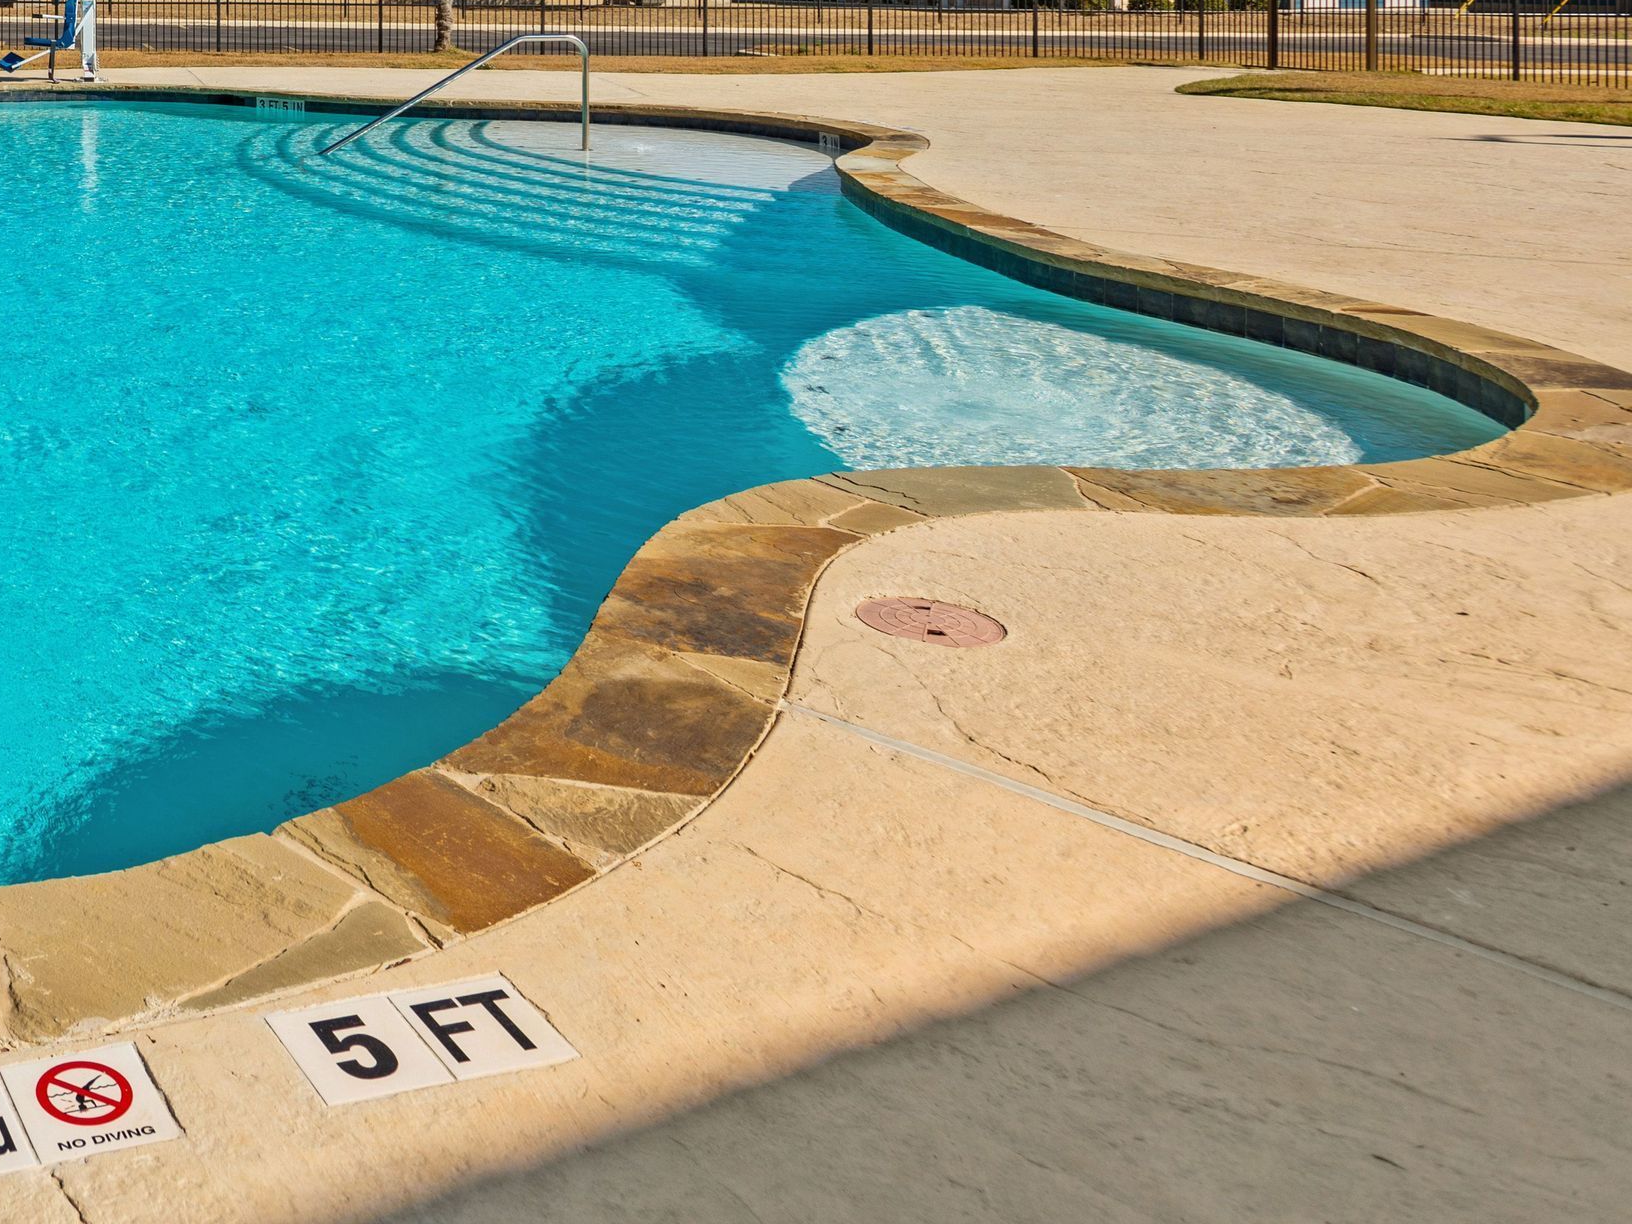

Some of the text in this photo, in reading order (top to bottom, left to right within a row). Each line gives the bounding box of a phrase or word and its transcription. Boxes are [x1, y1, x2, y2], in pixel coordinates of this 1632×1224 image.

[259, 99, 303, 112] 3 FT 5 IN
[307, 989, 538, 1080] 5 FT
[57, 1126, 156, 1151] NO DIVING
